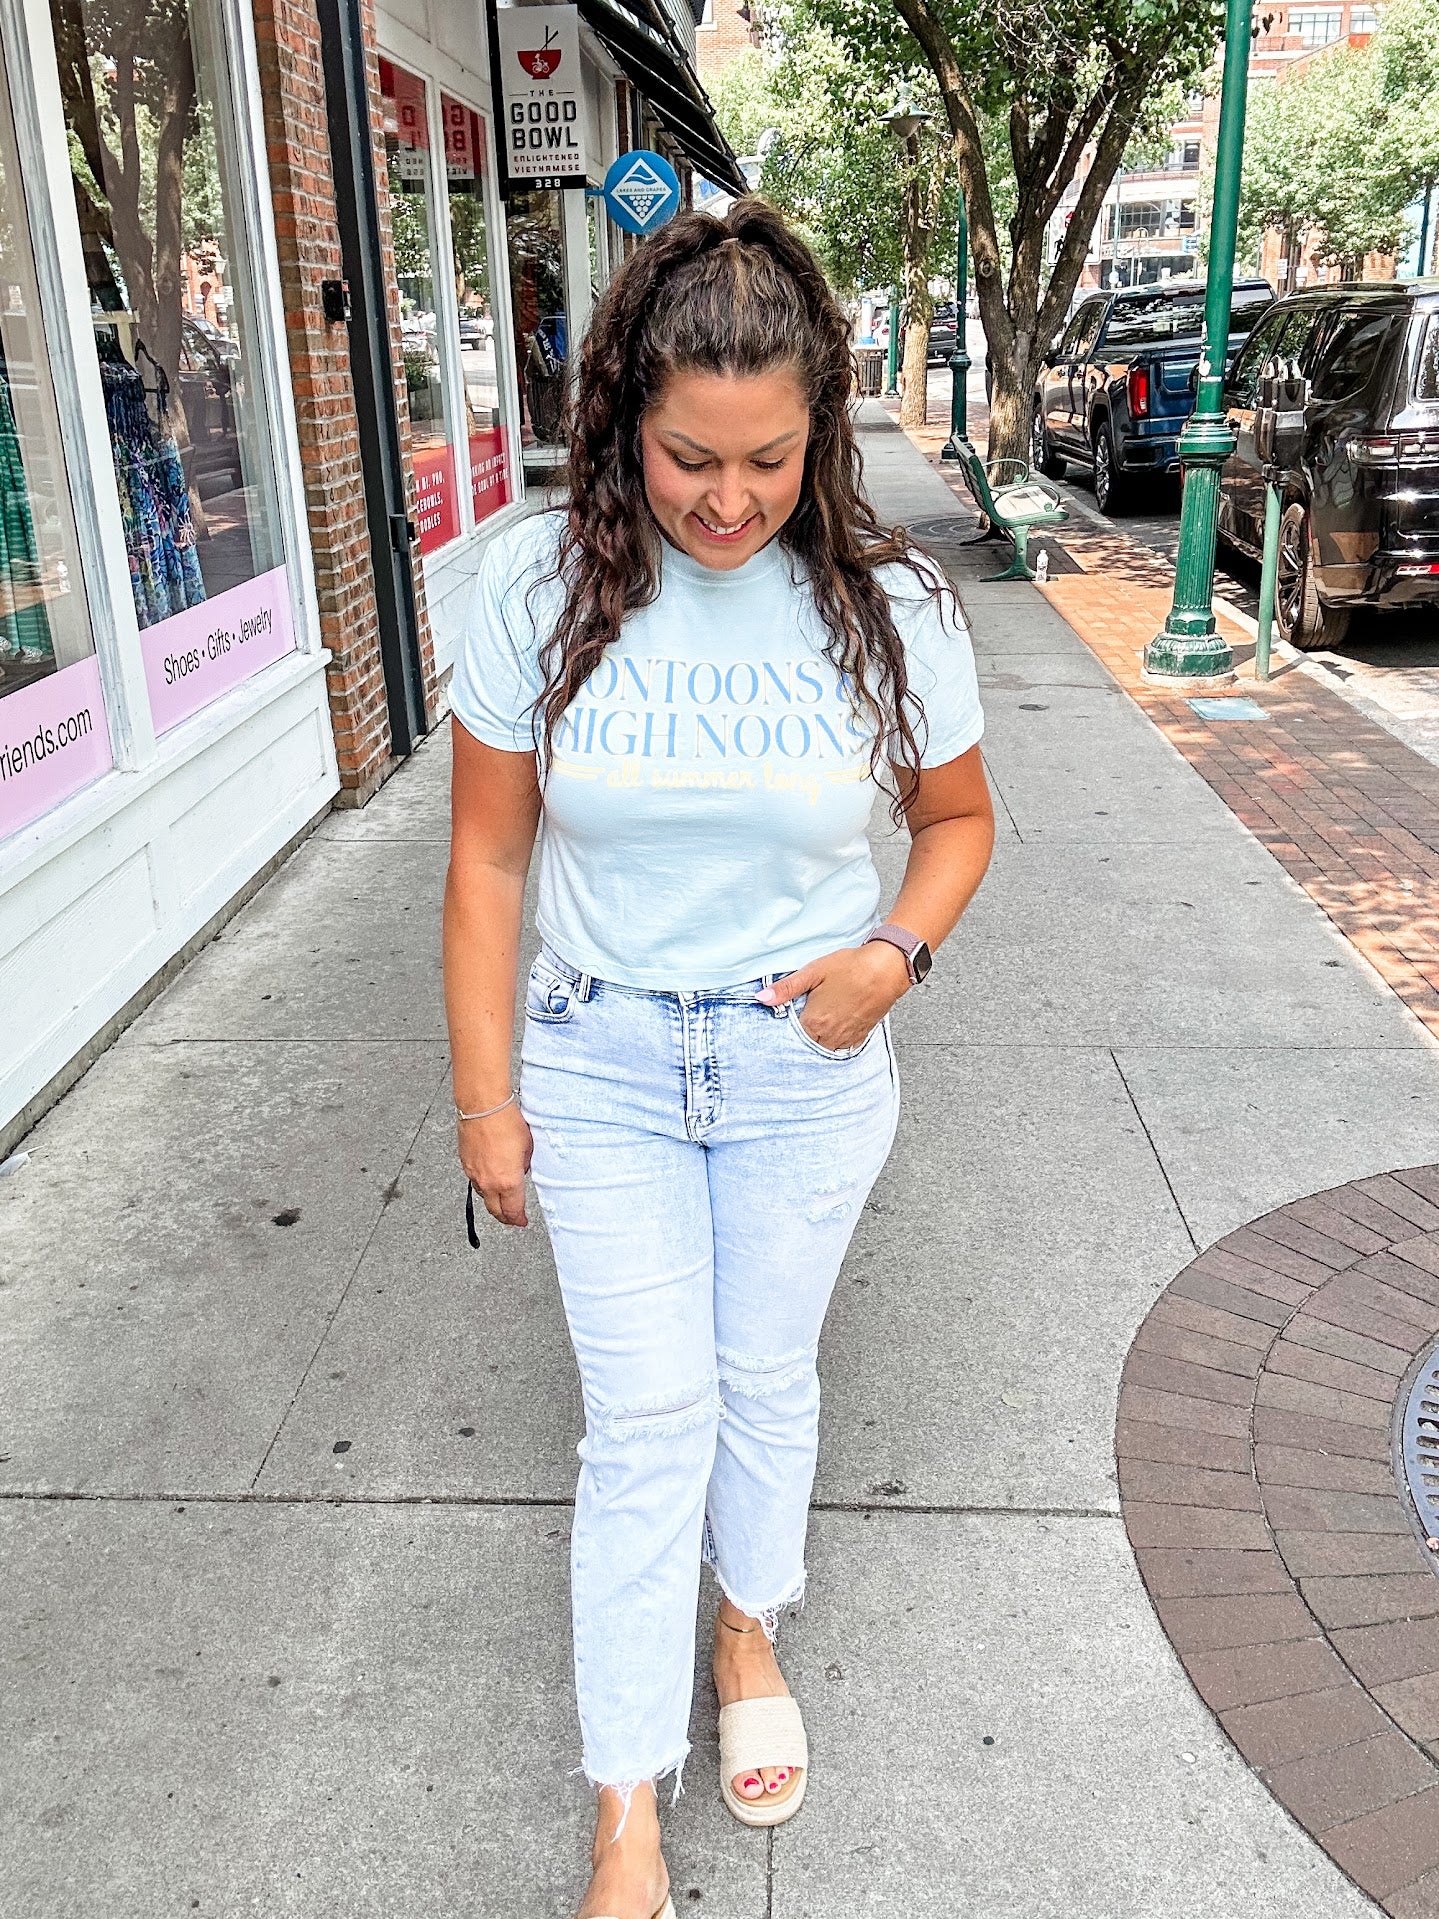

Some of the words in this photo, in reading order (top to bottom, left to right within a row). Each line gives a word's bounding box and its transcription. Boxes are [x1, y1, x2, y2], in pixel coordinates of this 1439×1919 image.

[529, 89, 554, 97] THE
[511, 100, 577, 124] GOOD
[512, 126, 578, 150] BOWL
[513, 153, 580, 163] ENLIGHTENED
[514, 164, 580, 174] VIETNAMESE
[535, 178, 561, 189] 328
[164, 653, 200, 685] Shoes
[207, 628, 231, 660] Gifts
[239, 606, 272, 644] Jewelry
[585, 655, 823, 705] ONTOONS
[0, 708, 93, 781] riends.com
[695, 713, 868, 760] NOONS
[607, 760, 643, 788] all
[651, 767, 755, 789] summer
[763, 761, 822, 806] long
